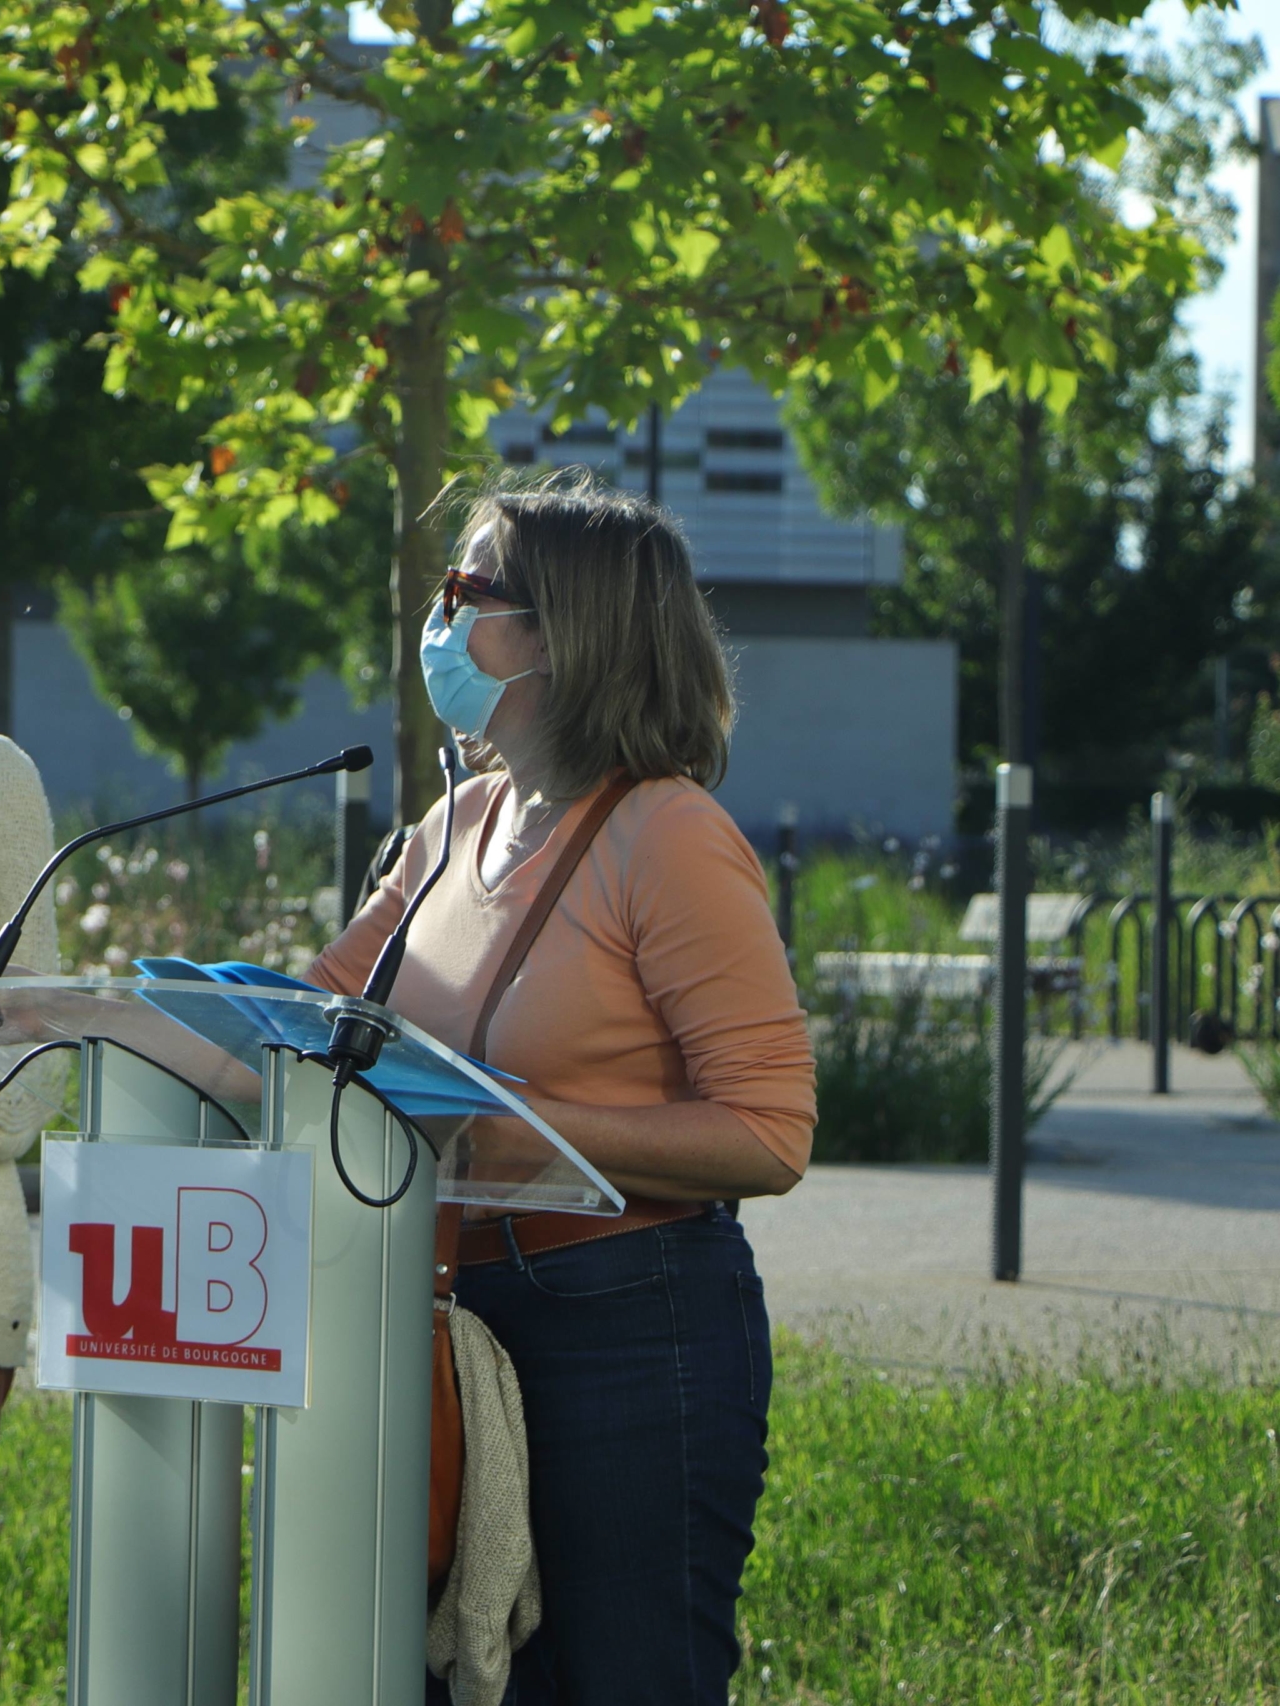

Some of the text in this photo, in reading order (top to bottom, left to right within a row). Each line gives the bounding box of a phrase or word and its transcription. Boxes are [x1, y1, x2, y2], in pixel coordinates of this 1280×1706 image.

[80, 1341, 268, 1366] UNIVERSITÉ DE BOURGOGNE
